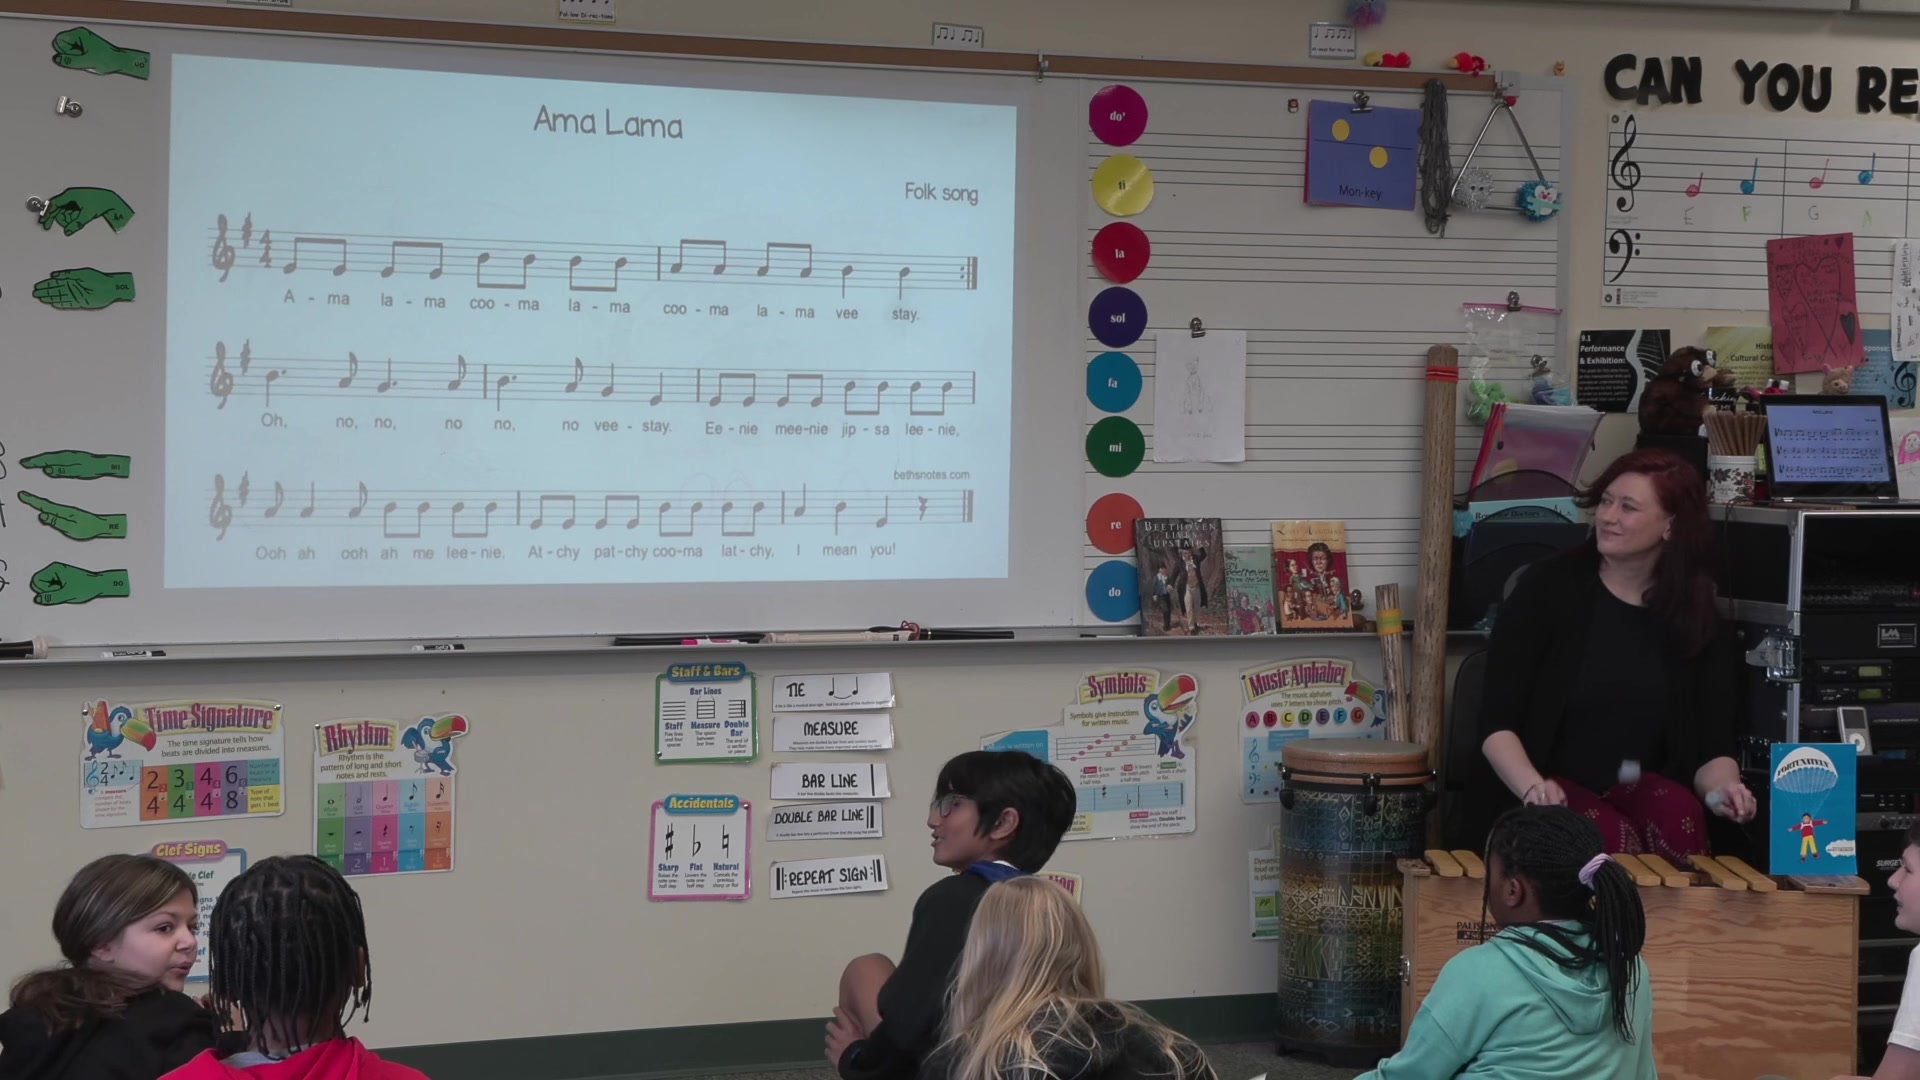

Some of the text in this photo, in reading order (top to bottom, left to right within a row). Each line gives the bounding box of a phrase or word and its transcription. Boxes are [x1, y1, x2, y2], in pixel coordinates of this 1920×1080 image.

[1604, 53, 1702, 106] CAN
[1735, 59, 1832, 112] YOU
[534, 104, 684, 140] Ama Lama
[1110, 110, 1125, 122] do'
[1118, 178, 1126, 190] ti
[905, 182, 979, 206] Folk song
[1339, 184, 1382, 201] Mon-key
[1682, 206, 1696, 226] E
[1742, 205, 1752, 223] F
[1808, 205, 1820, 221] G
[1114, 247, 1125, 259] la
[836, 308, 858, 319] vee
[892, 306, 919, 321] stay.
[1110, 311, 1125, 323] sol
[1580, 345, 1625, 353] Performance
[1108, 377, 1118, 388] fa
[261, 413, 288, 429] Oh,
[336, 417, 358, 430] no,
[374, 417, 396, 430] no,
[445, 418, 462, 430] no
[494, 418, 515, 432] no,
[562, 420, 579, 431] no
[594, 420, 618, 432] vee
[642, 420, 672, 434] stay.
[776, 424, 828, 435] mee-nie
[1109, 442, 1122, 452] mi
[894, 470, 970, 480] bethsnotes.com
[1111, 520, 1122, 529] re
[1144, 522, 1217, 531] BEETHOVEN
[1153, 539, 1210, 547] UPSTAIRS
[255, 545, 286, 560] Ooh
[298, 546, 315, 560] ah
[341, 546, 368, 559] ooh
[380, 546, 398, 559] ah
[413, 548, 434, 559] me
[823, 544, 857, 556] mean
[870, 543, 896, 558] you!
[1108, 586, 1121, 598] do
[672, 665, 740, 677] Staff & Bars
[1249, 661, 1347, 697] Music Alphabet
[786, 682, 805, 697] TIE
[1088, 672, 1148, 702] Symbols
[145, 703, 272, 732] Time Signature
[1248, 709, 1361, 724] A B C D E F G
[665, 722, 683, 730] Staff
[691, 721, 720, 729] Measure
[804, 721, 859, 736] MEASURE
[168, 735, 263, 748] The time signature tells how
[325, 721, 389, 754] Rhythm
[162, 748, 180, 758] beats
[194, 746, 220, 756] divided
[236, 745, 272, 753] measures.
[338, 754, 364, 762] Rhythm
[320, 764, 344, 773] pattern
[346, 762, 353, 770] of
[354, 762, 368, 772] long
[370, 770, 388, 778] rests.
[1777, 758, 1830, 777] FORTUNATELY
[147, 770, 159, 790] 2
[174, 769, 185, 788] 3
[200, 767, 213, 785] 4
[225, 766, 238, 784] 6
[802, 774, 858, 788] BAR LINE
[146, 796, 160, 815] 4
[172, 794, 186, 813] 4
[200, 792, 213, 810] 4
[226, 791, 238, 809] 8
[669, 797, 734, 809] Accidentals
[774, 809, 864, 824] DOUBLE BAR LINE
[156, 843, 221, 857] Clef Signs
[658, 863, 679, 873] Sharp
[198, 871, 214, 879] Clef
[789, 867, 868, 886] REPEAT SIGN
